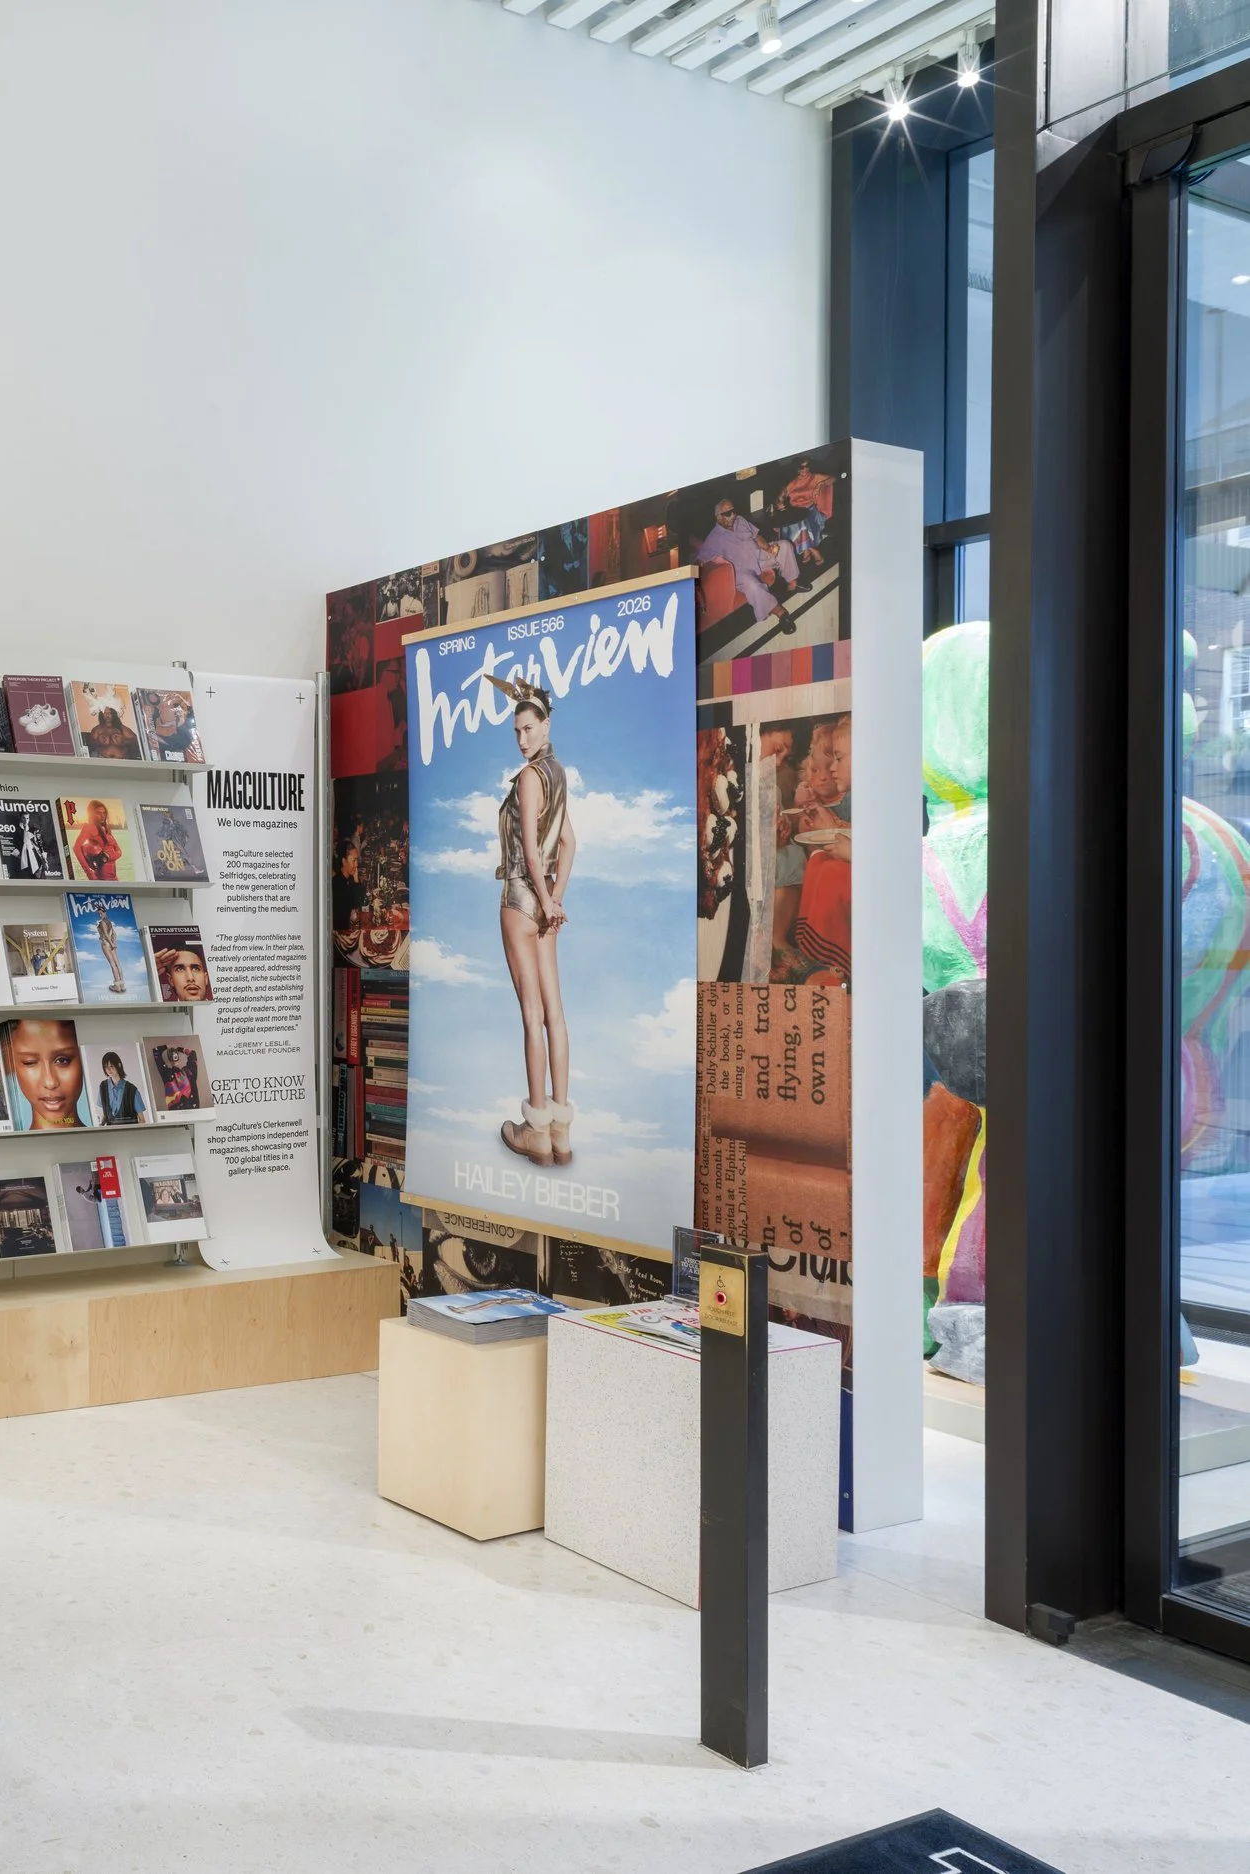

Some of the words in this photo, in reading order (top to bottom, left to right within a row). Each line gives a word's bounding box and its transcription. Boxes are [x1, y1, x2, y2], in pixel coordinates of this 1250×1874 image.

[438, 636, 476, 656] SPRING
[508, 620, 542, 641] ISSUE
[542, 616, 564, 634] 566
[617, 595, 651, 618] 2026
[416, 592, 678, 766] Interview
[207, 770, 305, 811] MAGCULTURE
[217, 818, 231, 827] We
[234, 819, 250, 827] love
[252, 819, 298, 830] magazines
[223, 850, 263, 858] magCulture
[243, 861, 279, 870] magazines
[220, 872, 257, 880] Selfridges,
[259, 872, 296, 881] celebrating
[251, 883, 287, 892] generation
[70, 894, 131, 918] Interview
[227, 894, 263, 902] publishers
[217, 905, 256, 914] reinventing
[23, 930, 47, 938] System
[751, 985, 770, 1034] trad
[811, 985, 829, 1041] way.
[707, 1013, 717, 1057] Schiller
[777, 1024, 801, 1102] flying,
[211, 1079, 240, 1091] GET
[243, 1078, 261, 1089] TO
[263, 1075, 305, 1088] KNOW
[706, 1058, 718, 1095] Dolly
[751, 1055, 770, 1100] and
[811, 1051, 825, 1105] own
[211, 1088, 305, 1104] MAGCULTURE
[216, 1122, 262, 1133] magCulture's
[263, 1119, 302, 1128] Clerkenwell
[207, 1136, 226, 1144] shop
[227, 1133, 265, 1142] champions
[267, 1130, 309, 1139] independent
[210, 1146, 250, 1155] magazines,
[251, 1142, 291, 1151] showcasing
[225, 1156, 239, 1164] 700
[241, 1154, 262, 1165] global
[263, 1153, 280, 1161] titles
[228, 1165, 266, 1177] gallery-like
[268, 1165, 290, 1173] space.
[454, 1160, 528, 1200] HAILEY
[535, 1175, 620, 1222] BIEBER
[444, 1212, 515, 1238] CONFERENCE
